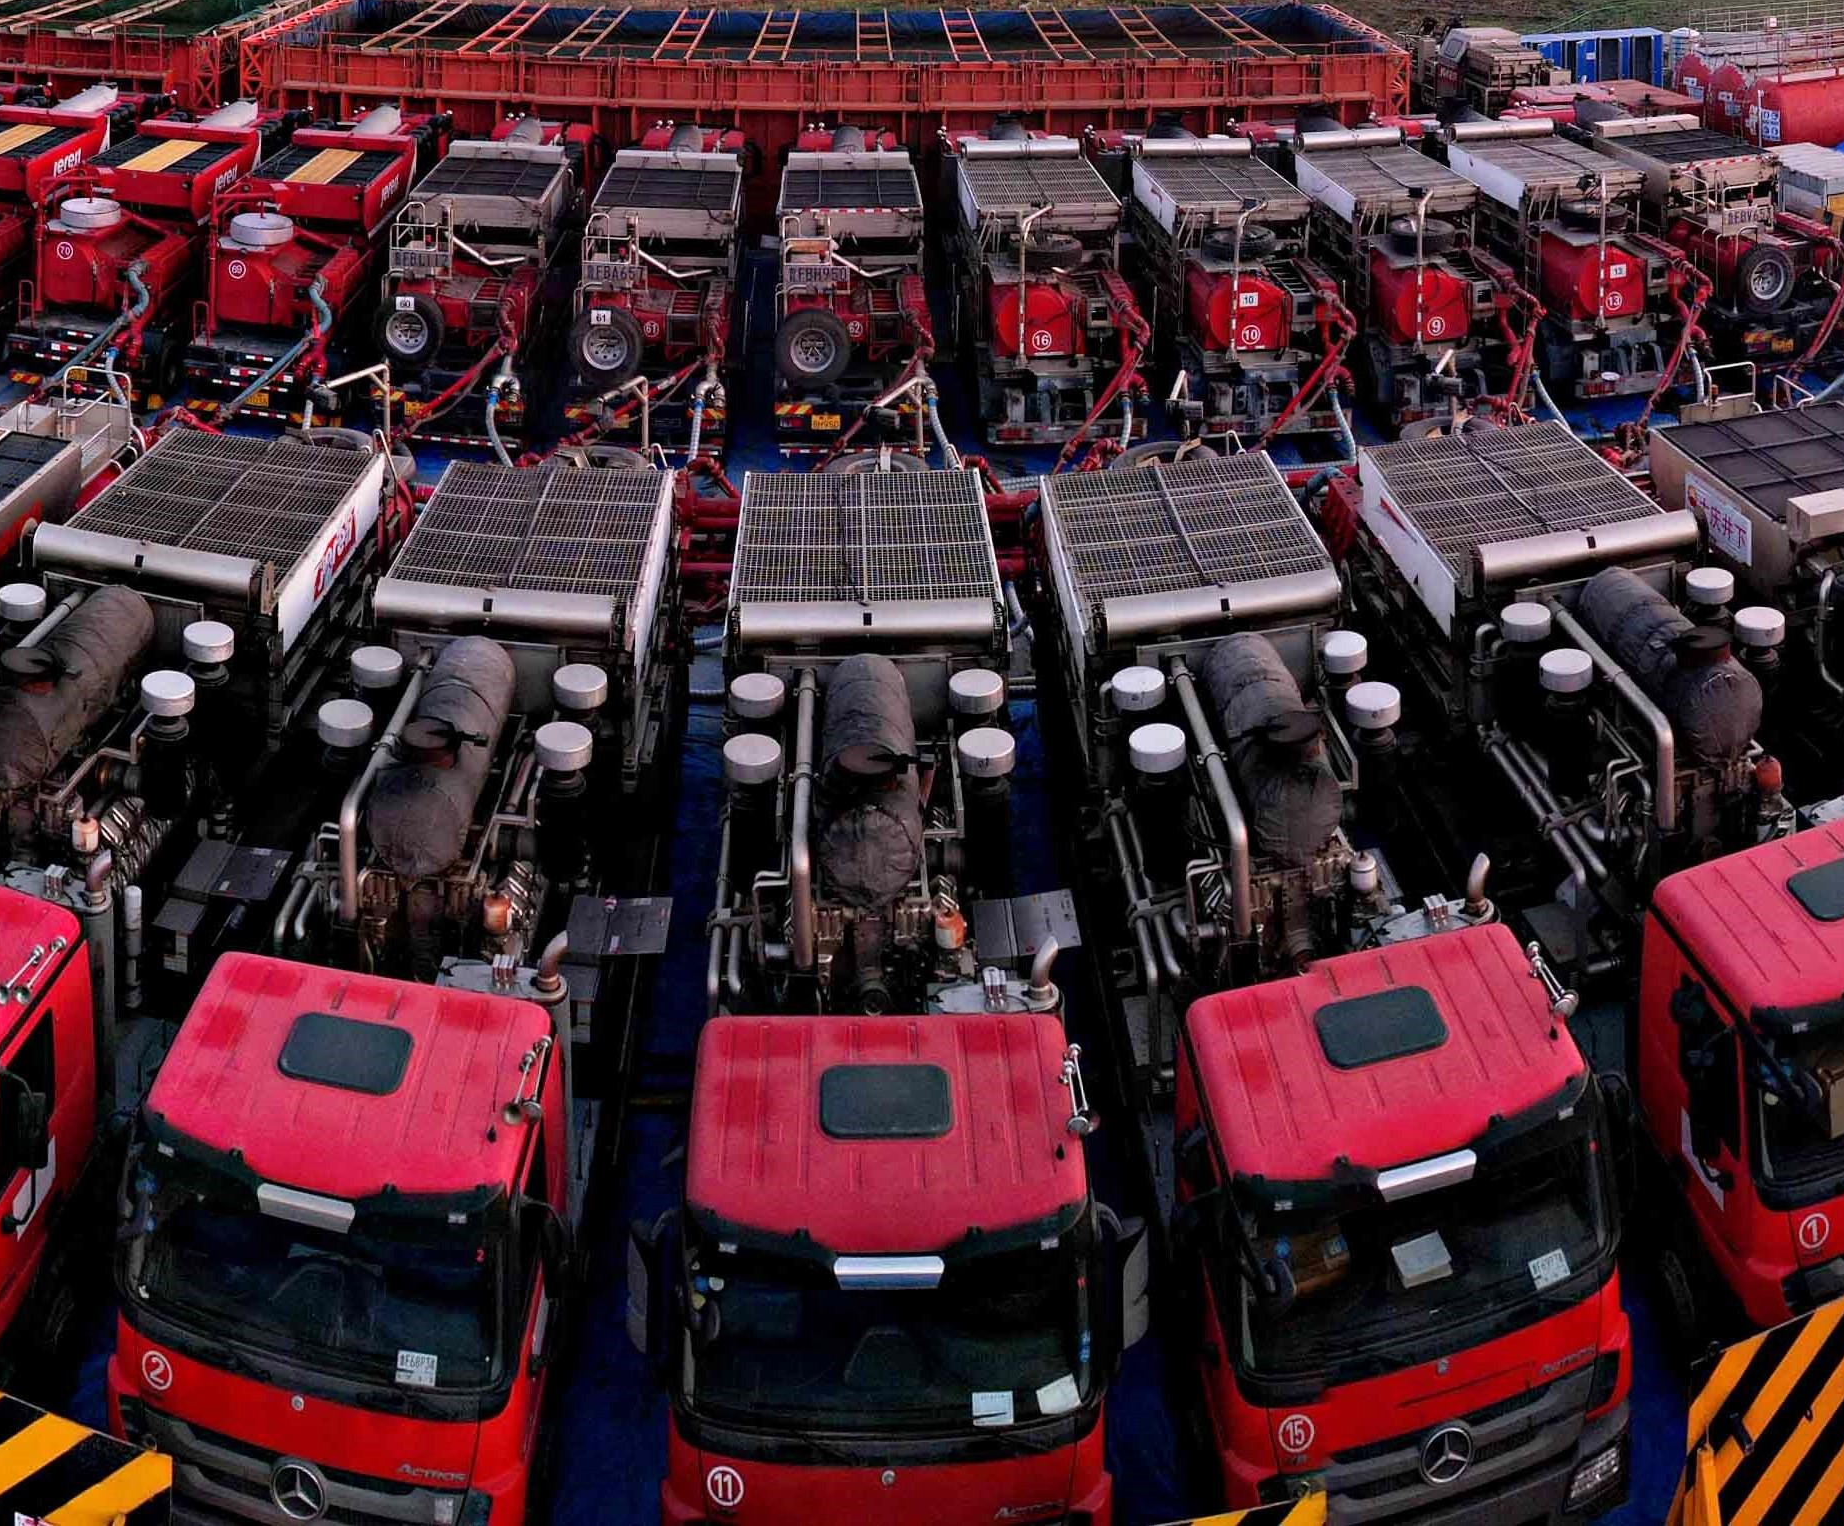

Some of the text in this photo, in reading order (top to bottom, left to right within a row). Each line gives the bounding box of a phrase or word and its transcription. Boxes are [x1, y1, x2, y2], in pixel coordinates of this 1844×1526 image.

[1243, 295, 1254, 304] 10
[595, 313, 607, 322] 61
[1287, 1419, 1305, 1446] 15
[713, 1474, 732, 1499] 11
